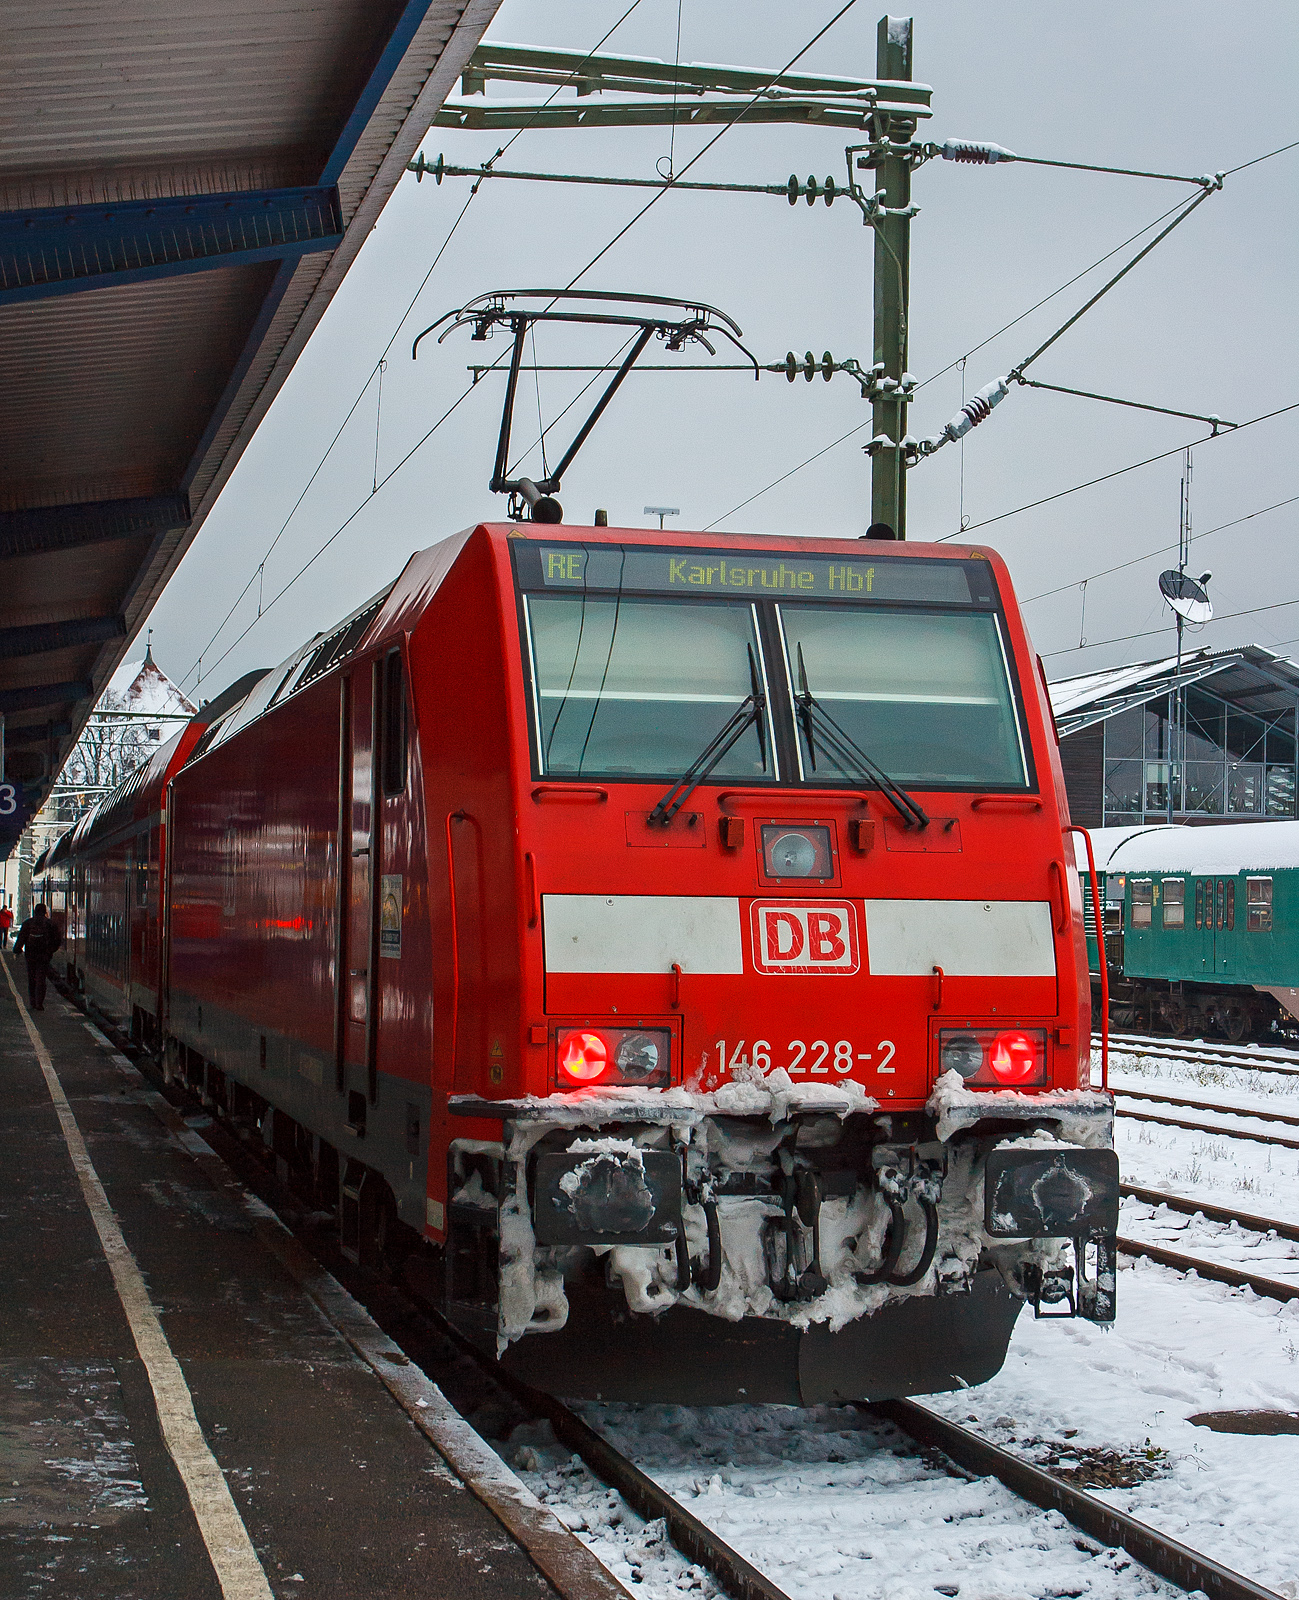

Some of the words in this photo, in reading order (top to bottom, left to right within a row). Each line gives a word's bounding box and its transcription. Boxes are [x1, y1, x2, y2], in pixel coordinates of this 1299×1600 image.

[547, 553, 583, 580] RE
[669, 558, 814, 589] Karlsruhe
[829, 565, 875, 592] Hbf
[0, 784, 17, 815] 3
[765, 911, 847, 962] DB
[715, 1039, 772, 1074] 146
[787, 1039, 896, 1074] 228-2
